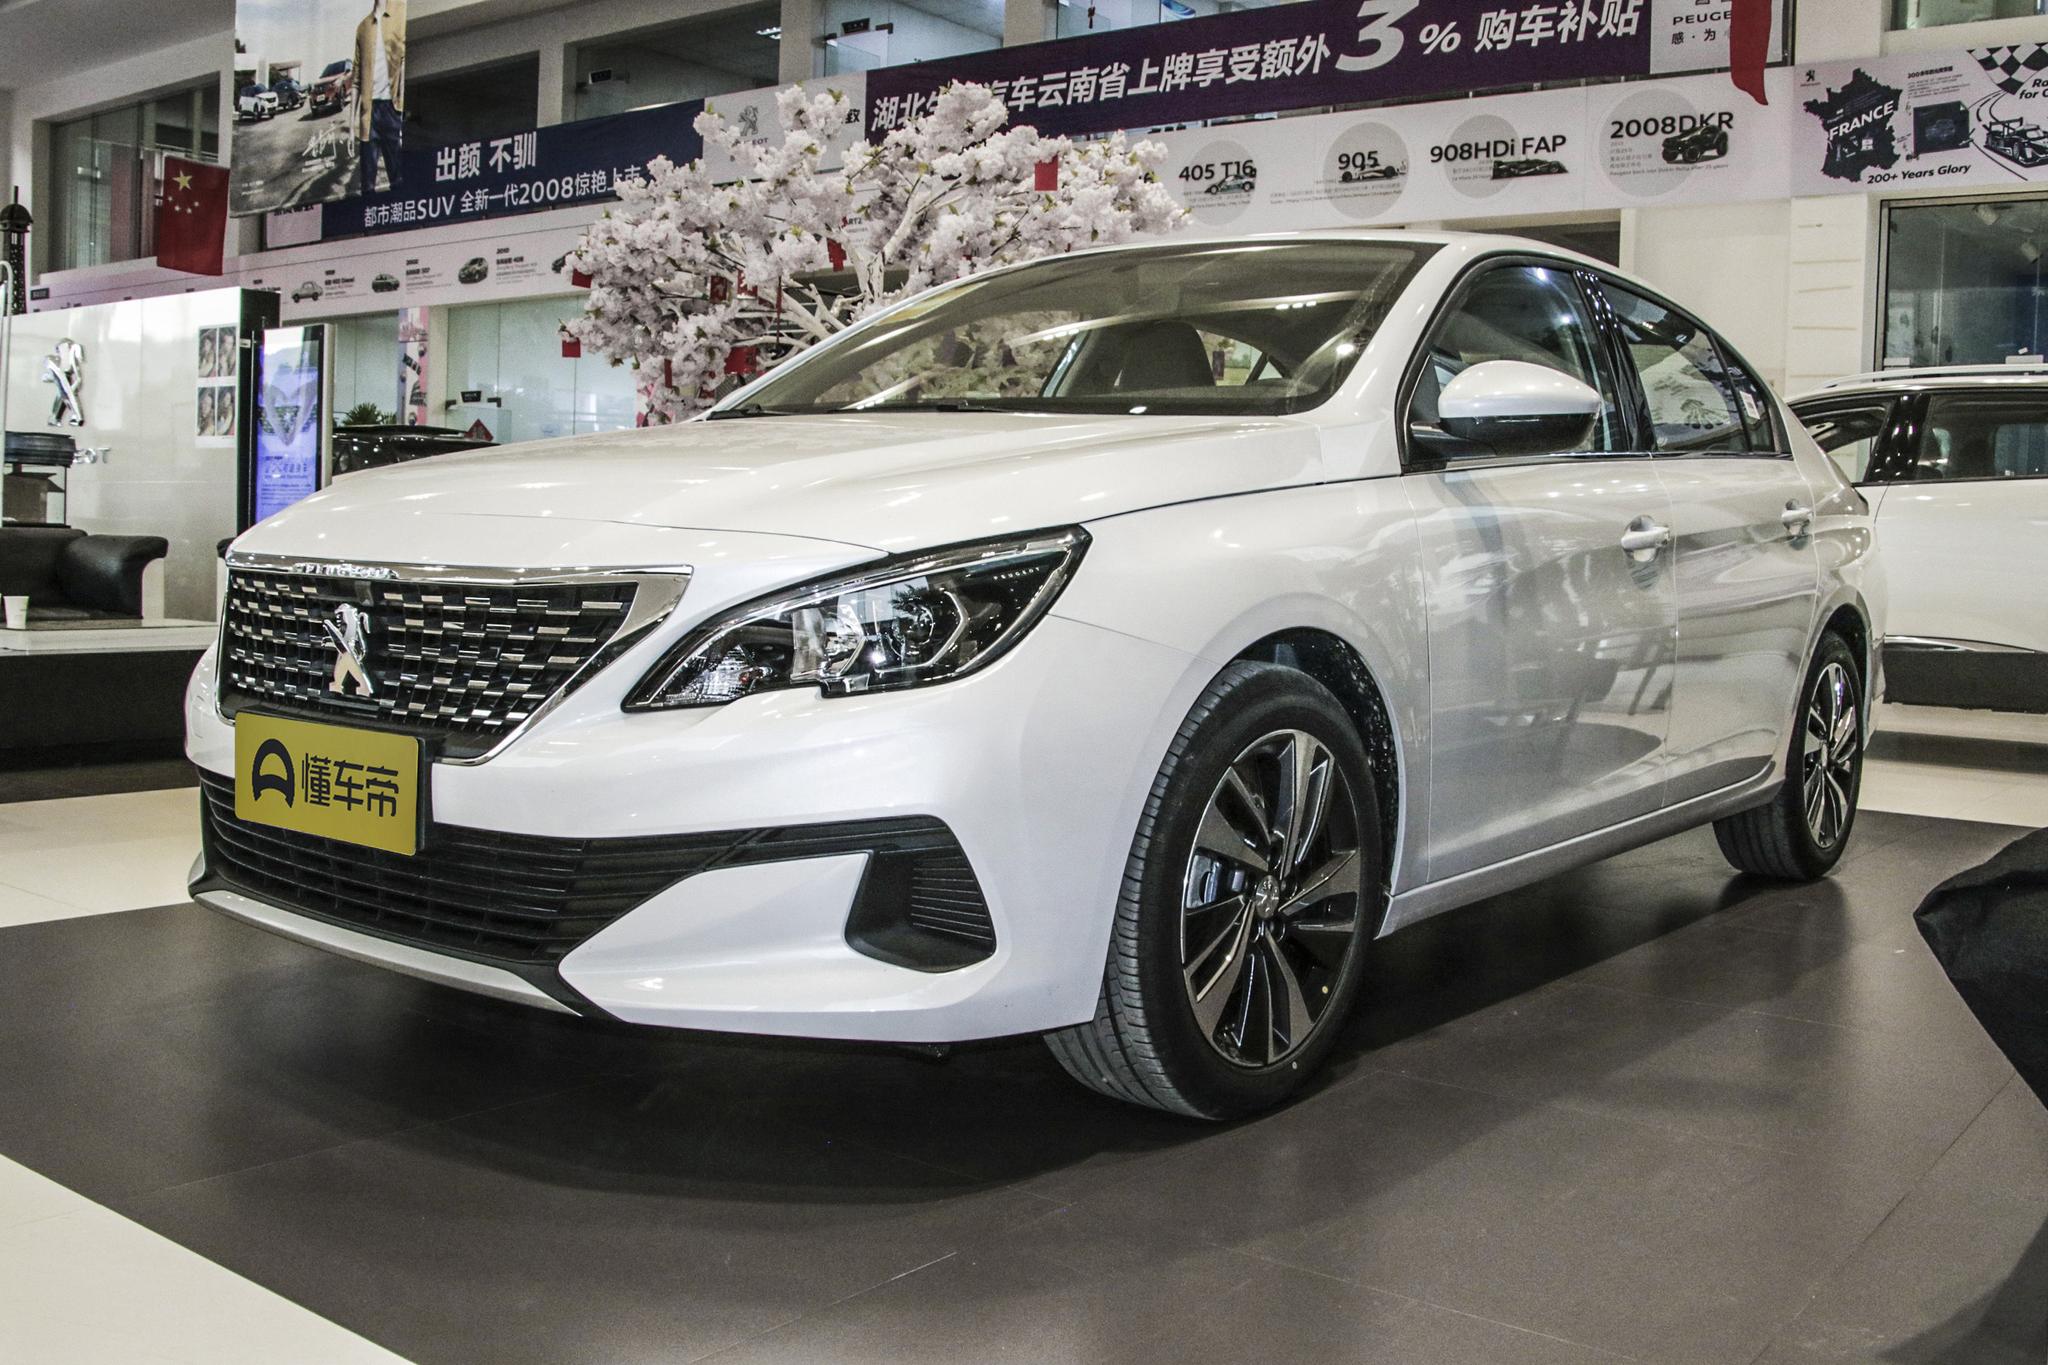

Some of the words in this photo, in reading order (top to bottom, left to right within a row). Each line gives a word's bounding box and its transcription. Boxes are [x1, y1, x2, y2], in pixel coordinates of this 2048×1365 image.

[2019, 89, 2039, 100] for
[1610, 111, 1734, 139] 2008DKR
[1829, 100, 1894, 141] FRANCE
[435, 142, 482, 182] 出颜
[489, 131, 538, 173] 不驯
[1338, 150, 1379, 170] 905
[1430, 138, 1515, 163] 908HDi
[1521, 134, 1567, 155] FAP
[1179, 163, 1216, 181] 405
[1221, 159, 1256, 179] T16
[1867, 173, 1898, 185] 200+
[1901, 169, 1935, 180] Years
[1937, 164, 1972, 176] Glory
[363, 194, 456, 228] 都市潮品SUV
[301, 752, 399, 818] 懂车帝
